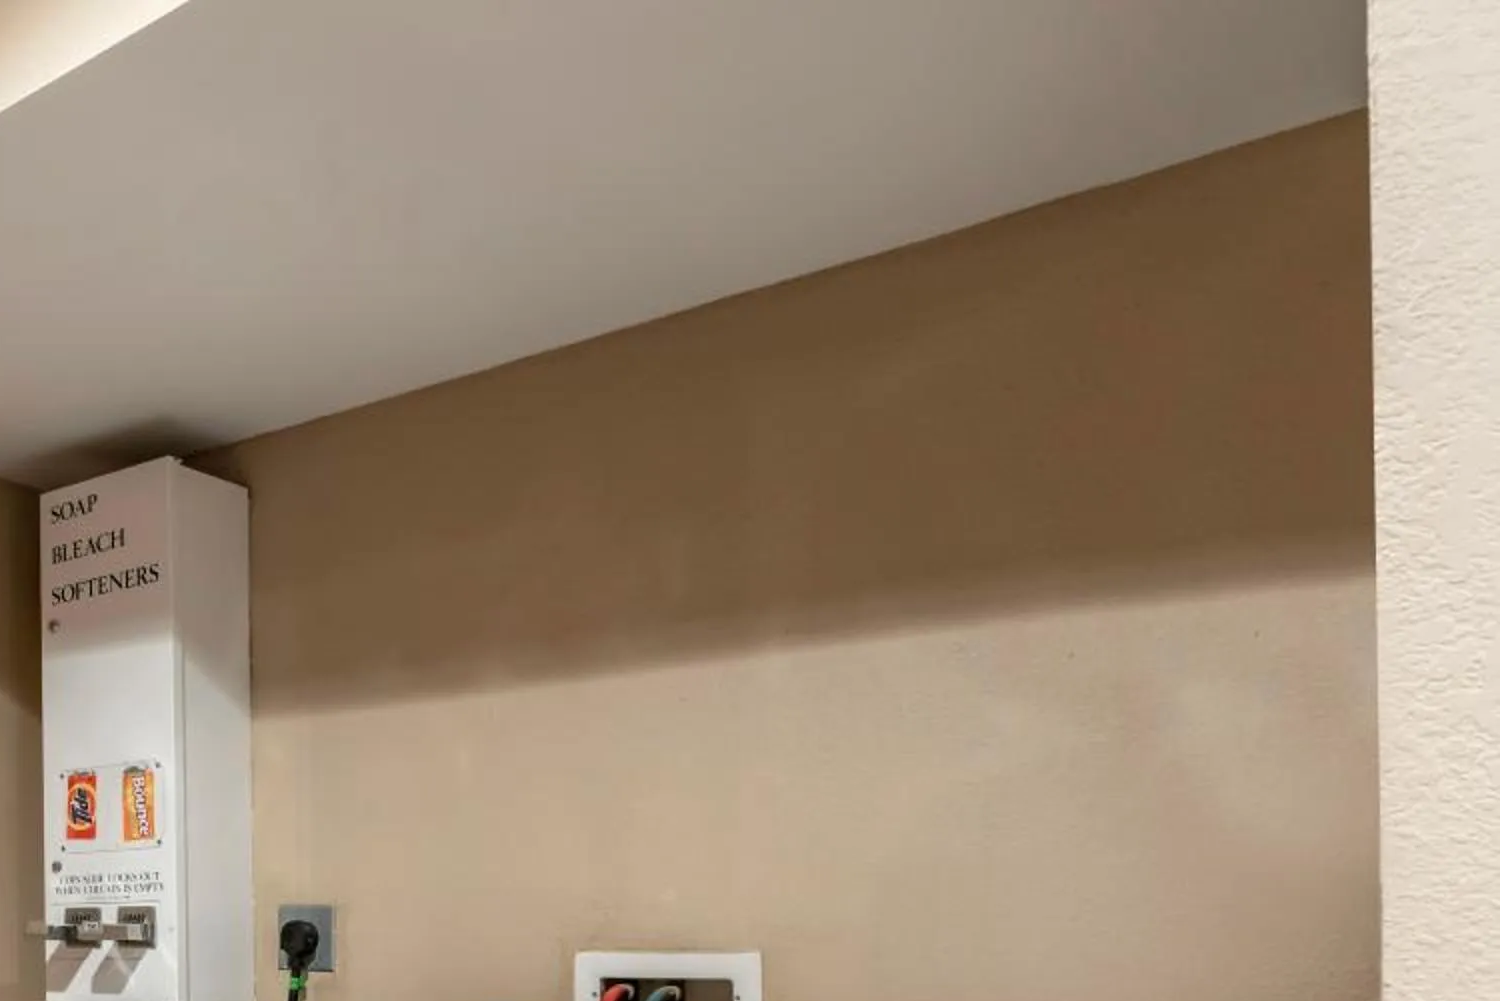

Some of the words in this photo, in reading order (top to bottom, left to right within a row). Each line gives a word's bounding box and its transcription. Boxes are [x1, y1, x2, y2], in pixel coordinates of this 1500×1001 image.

[51, 494, 98, 524] SOAP
[51, 528, 125, 564] BLEACH
[51, 563, 160, 606] SOFTENERS
[71, 787, 93, 825] Tide
[132, 775, 149, 836] Bounce
